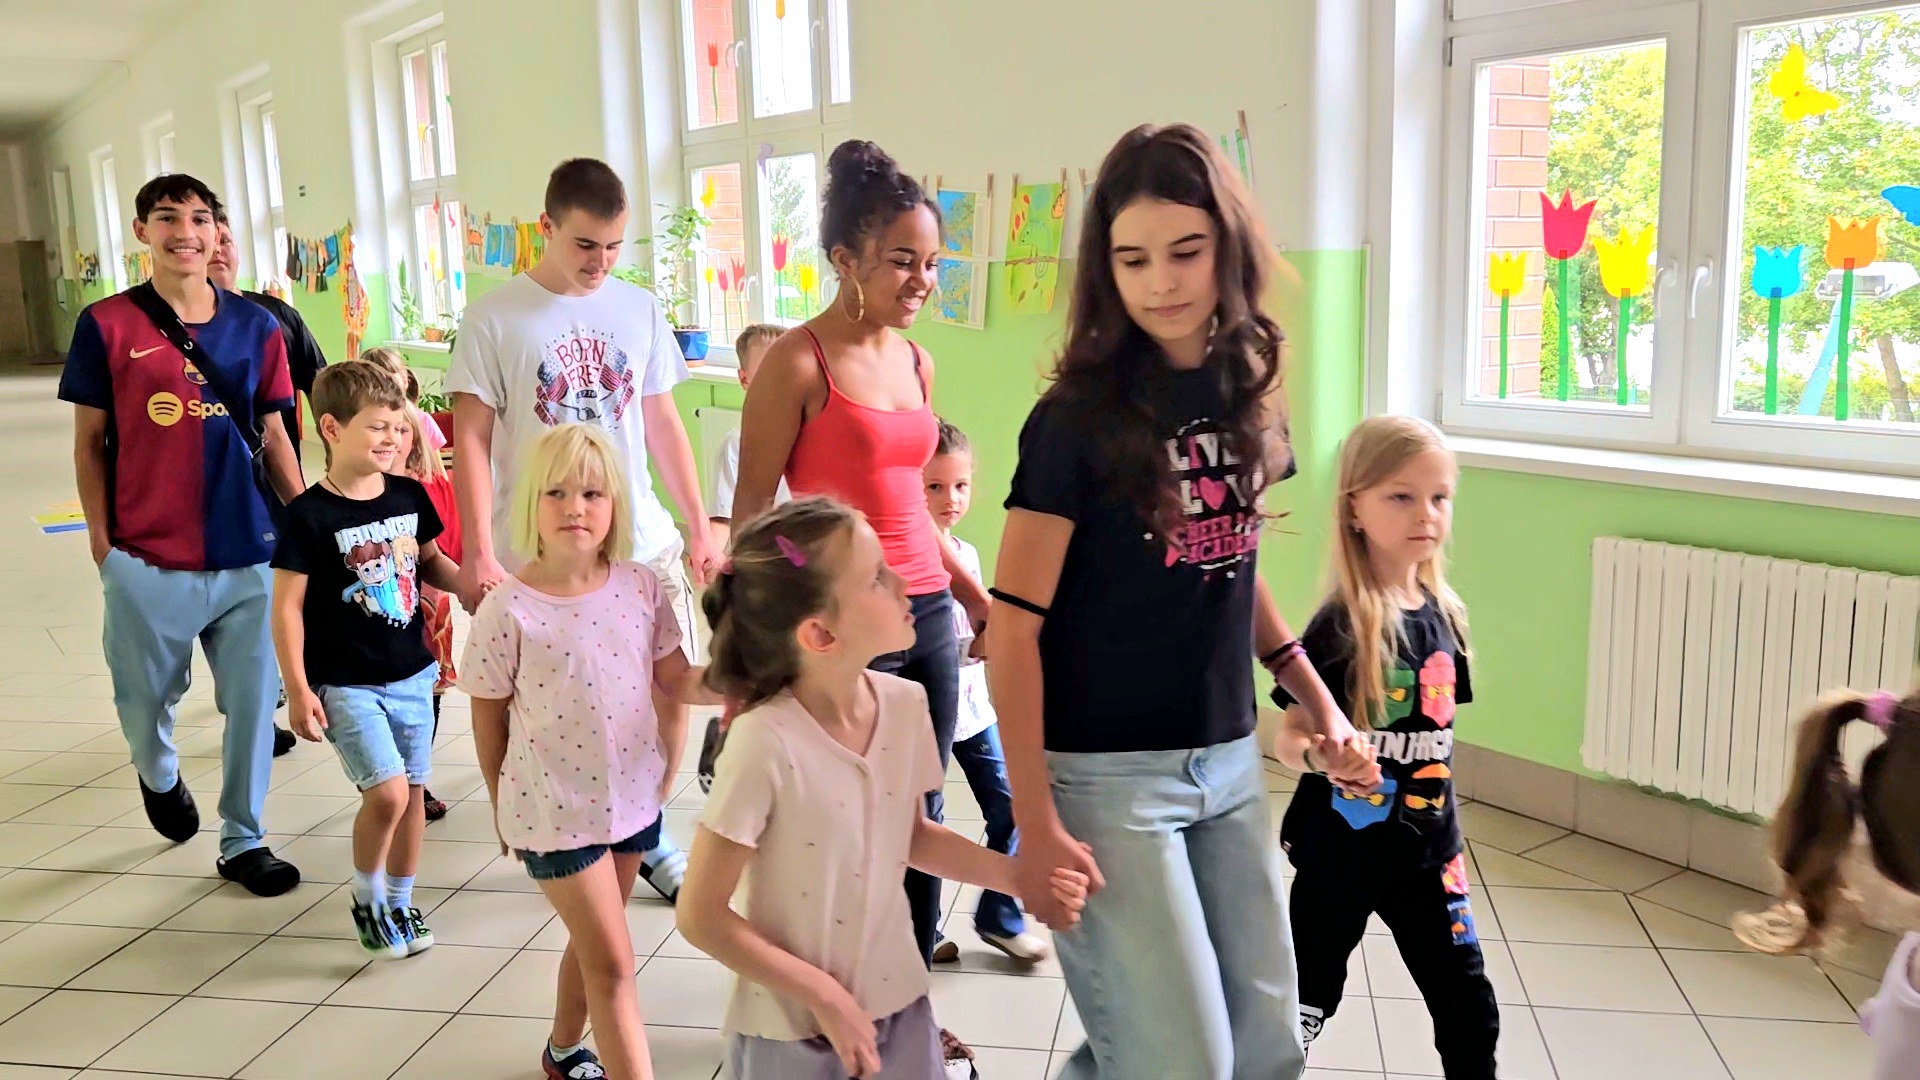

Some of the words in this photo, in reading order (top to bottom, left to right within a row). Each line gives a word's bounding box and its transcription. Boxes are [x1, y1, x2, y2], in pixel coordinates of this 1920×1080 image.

[555, 338, 606, 369] BORN
[187, 399, 230, 420] Spo
[1370, 728, 1454, 765] INJAGO
